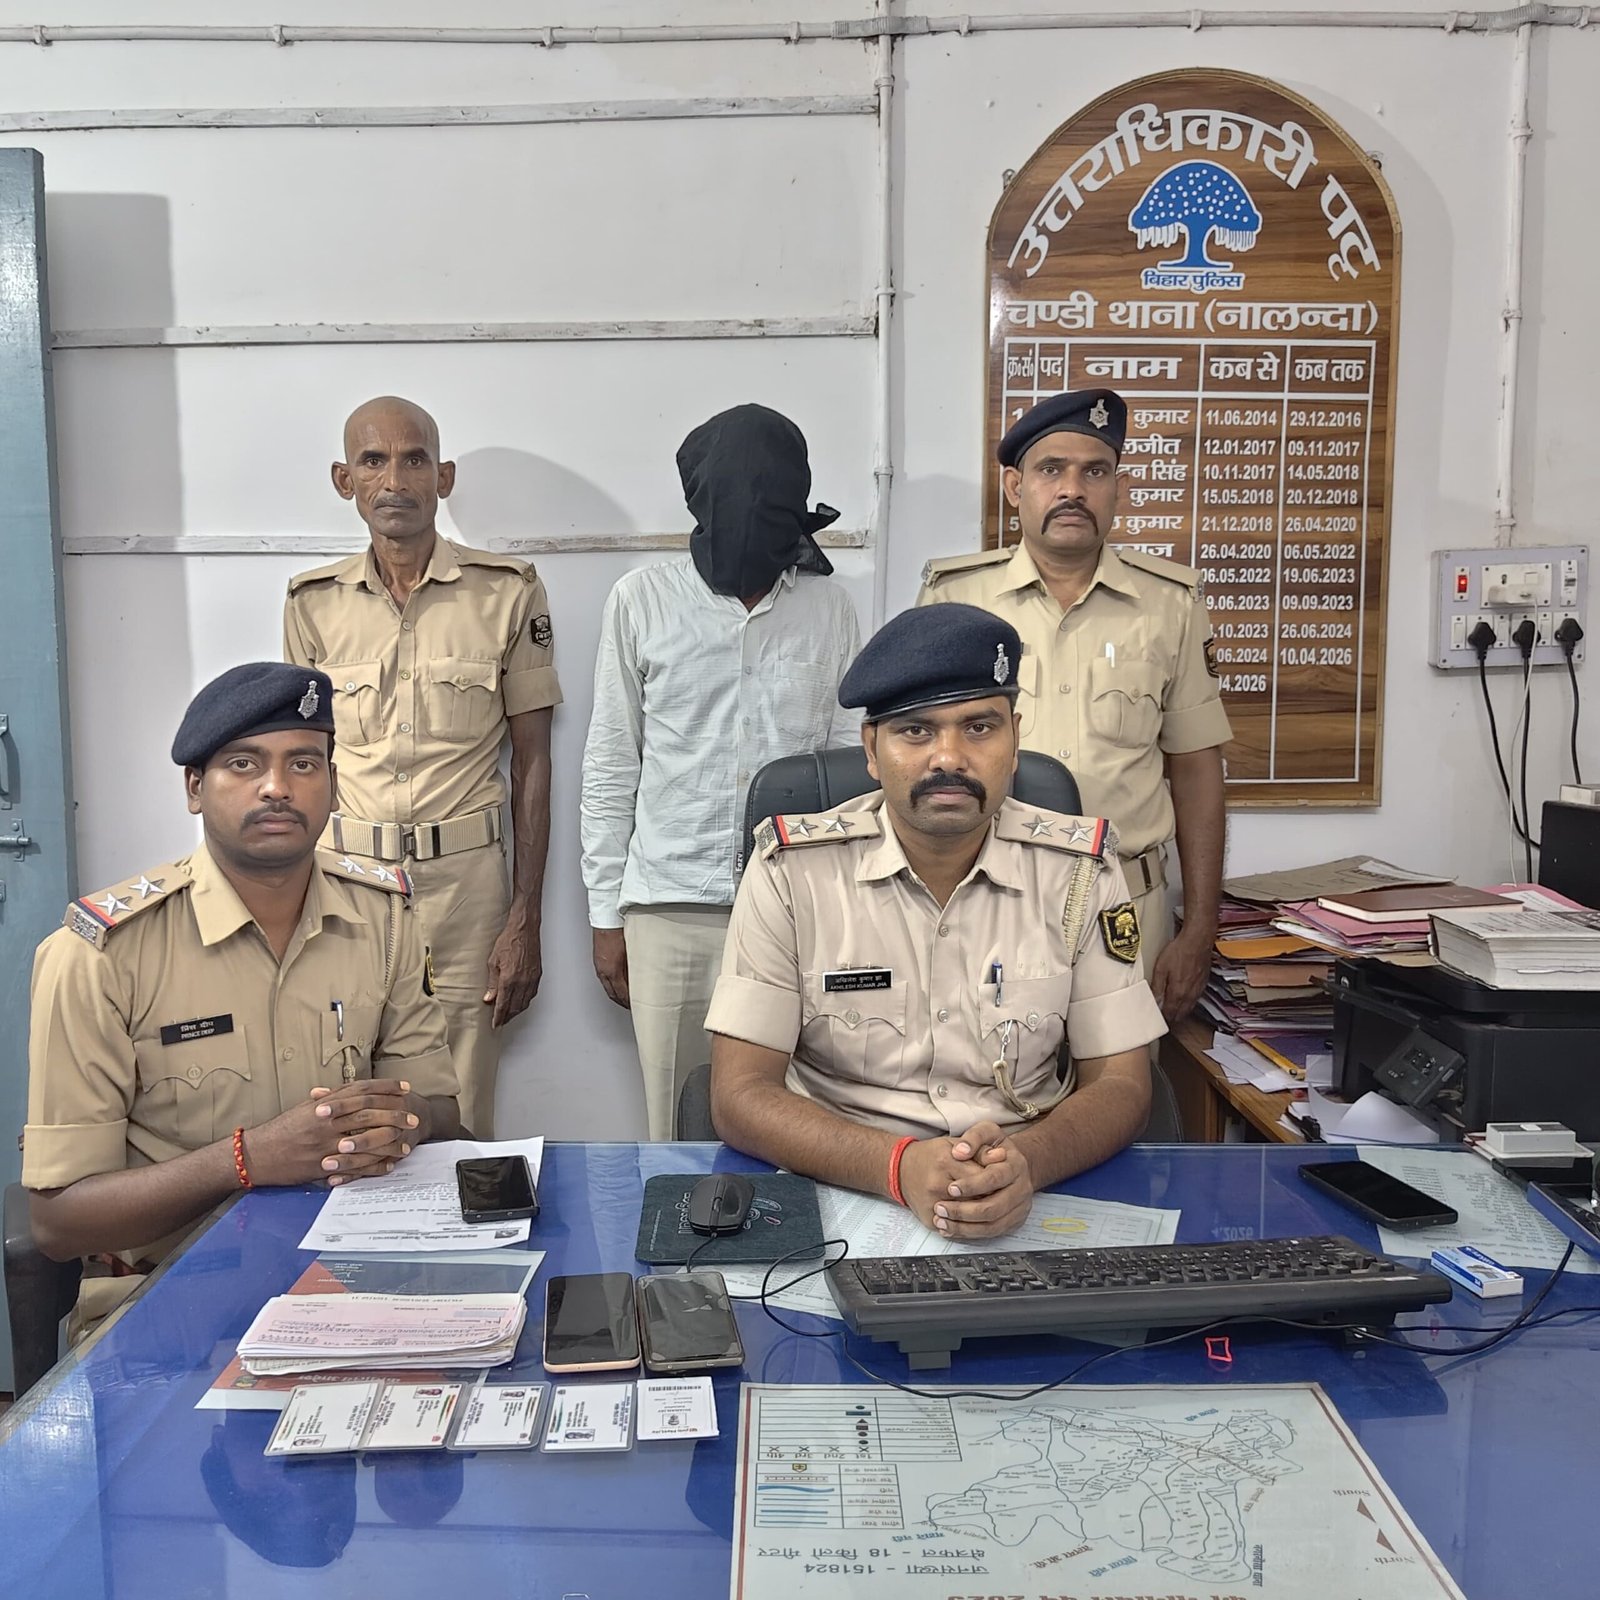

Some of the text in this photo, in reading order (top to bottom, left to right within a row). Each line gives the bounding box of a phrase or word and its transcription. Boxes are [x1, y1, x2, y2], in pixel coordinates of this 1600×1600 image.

[1144, 270, 1241, 290] बिहार पुलिस
[1005, 290, 1379, 335] चण्डी थाना (नालन्दा)
[1039, 356, 1063, 377] पद
[1084, 357, 1182, 380] नाम
[1209, 352, 1280, 381] कब से
[1294, 359, 1365, 382] कब तक
[1133, 409, 1191, 429] कुमार
[1206, 410, 1278, 426] 11.06.2014
[1289, 411, 1362, 428] 29.12.2016
[1121, 433, 1182, 455] लजीत
[1203, 439, 1275, 456] 12.01.2017
[1287, 441, 1360, 457] 09.11.2017
[1151, 458, 1189, 481] सिंह
[1203, 464, 1275, 480] 10.11.2017
[1287, 464, 1360, 481] 14.05.2018
[1129, 488, 1186, 507] कुमार
[1202, 488, 1274, 505] 15.05.2018
[1286, 489, 1358, 505] 20.12.2018
[1009, 516, 1020, 531] 5
[1125, 515, 1184, 535] कुमार
[1201, 516, 1273, 532] 21.12.2018
[1284, 516, 1357, 533] 26.04.2020
[1200, 543, 1272, 559] 26.04.2020
[1283, 544, 1356, 560] 06.05.2022
[1283, 567, 1355, 584] 19.06.2023
[1206, 595, 1270, 610] 9.06.2023
[1282, 594, 1354, 611] 09.09.2023
[1211, 623, 1269, 639] .10.2023
[1280, 622, 1352, 639] 26.06.2024
[1216, 648, 1268, 663] 06.2024
[1279, 648, 1352, 665] 10.04.2026
[1219, 675, 1267, 692] 4.2026
[824, 1451, 846, 1459] 2nd
[1332, 1489, 1371, 1497] South
[755, 1547, 801, 1560] मीटर
[812, 1548, 857, 1560] किलो
[869, 1548, 891, 1558] 18
[922, 1548, 986, 1561] क्षेत्रफल
[1374, 1556, 1416, 1565] North
[804, 1563, 876, 1574] 151824
[906, 1564, 990, 1577] जनसंख्या
